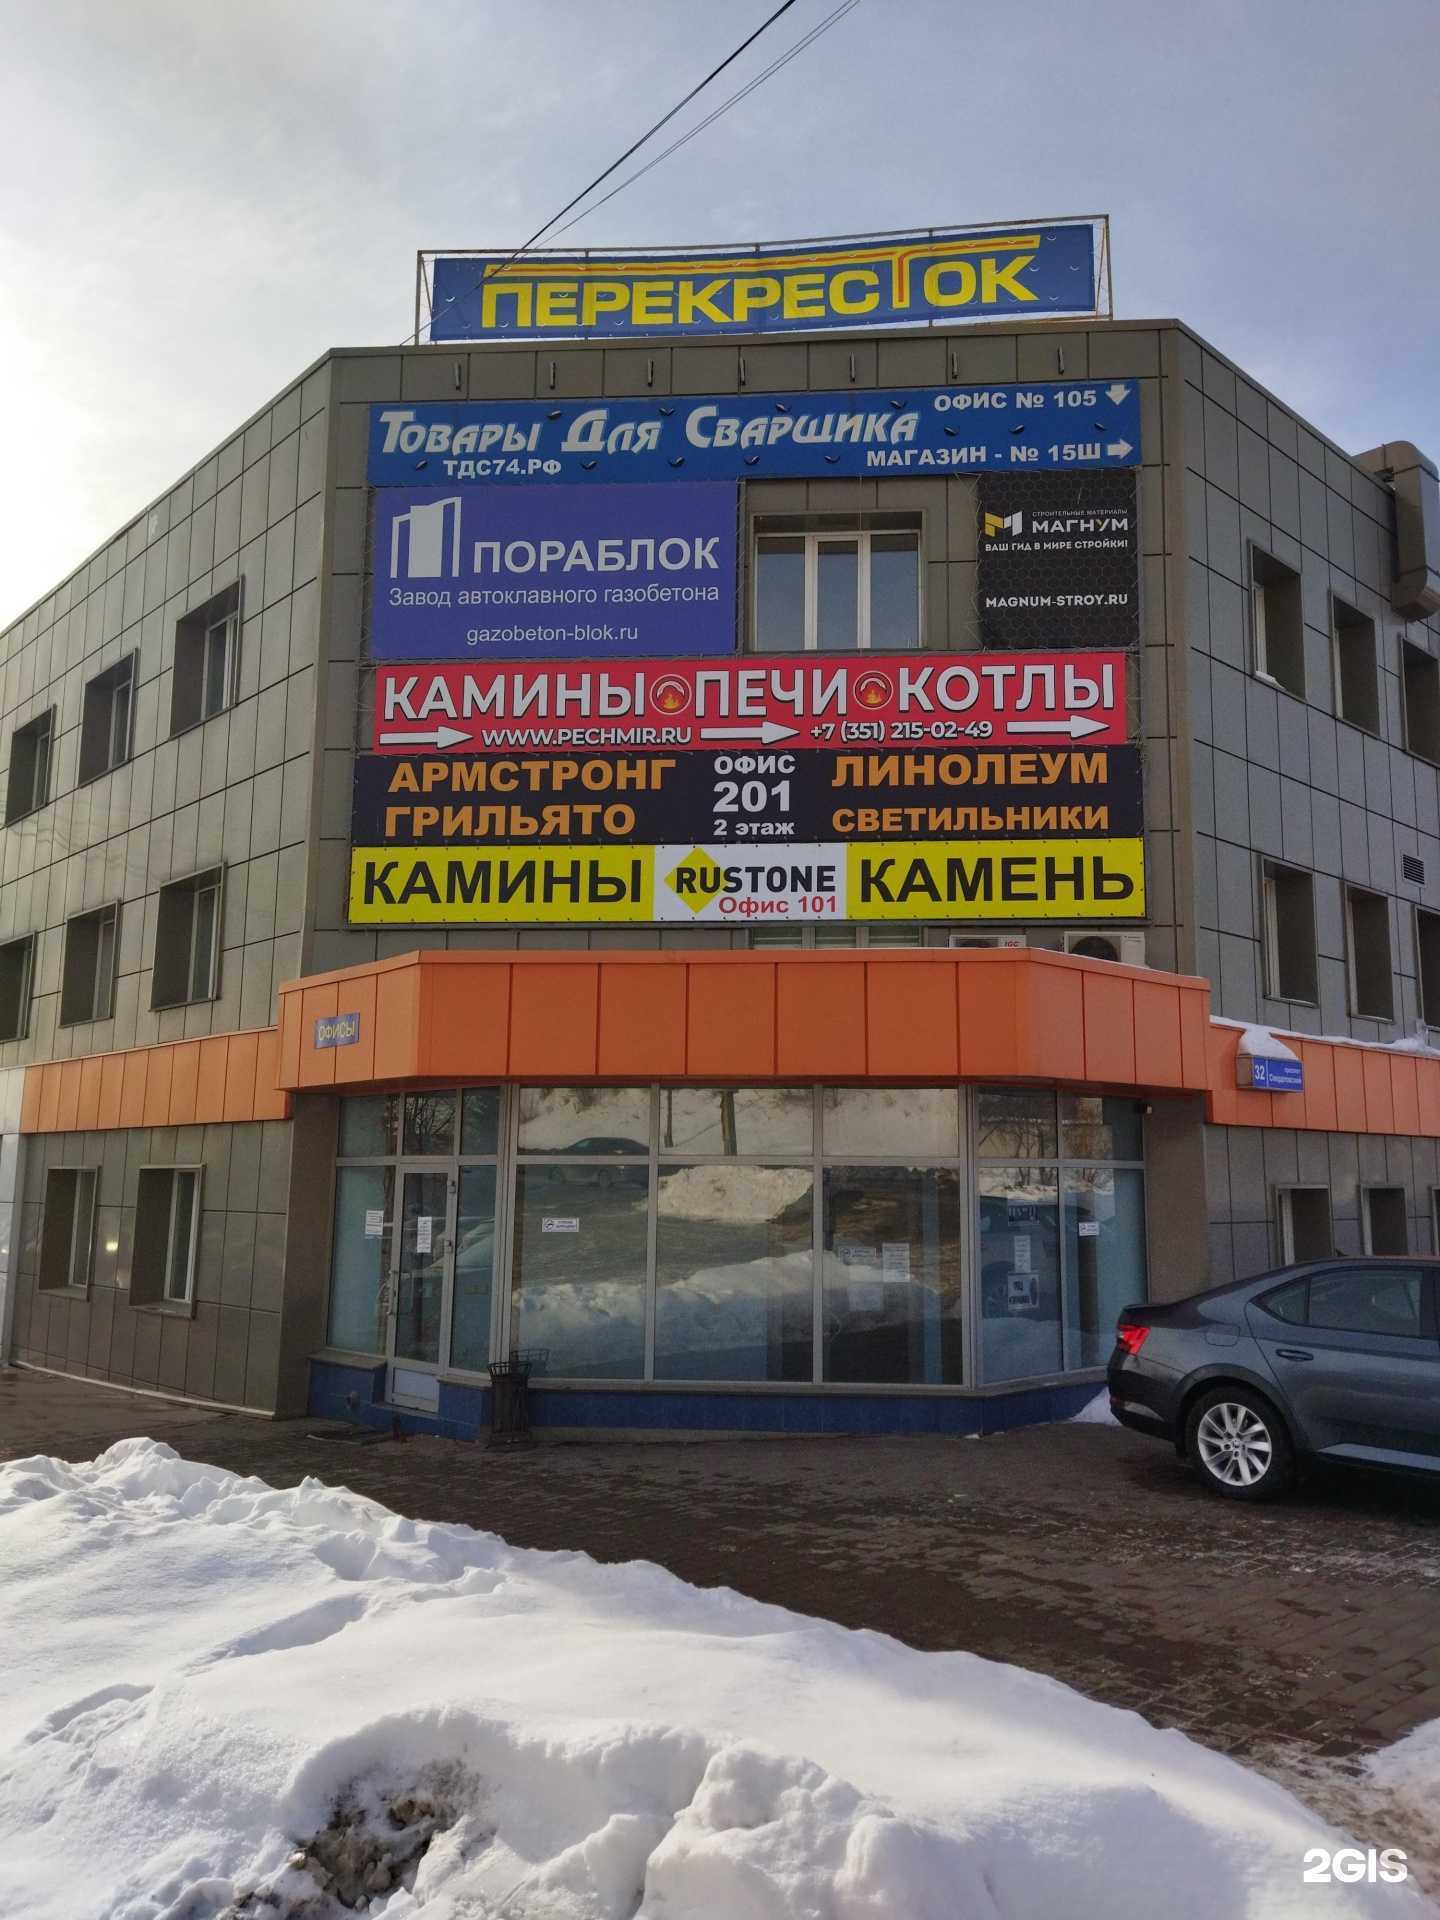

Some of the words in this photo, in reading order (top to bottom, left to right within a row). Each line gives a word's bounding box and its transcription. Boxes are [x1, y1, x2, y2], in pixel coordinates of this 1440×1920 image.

[482, 235, 1041, 329] ПЕРЕКРЕСТОК
[934, 393, 1007, 412] ОФИС
[1016, 392, 1045, 409] №
[1053, 390, 1097, 408] 105
[866, 446, 987, 467] МАГАЗИН
[1010, 446, 1039, 463] №
[1048, 442, 1101, 462] 15Ш
[443, 458, 562, 480] ТДС74.РФ
[1032, 518, 1129, 533] МАГНУМ
[473, 537, 720, 574] ПОРАБЛОК
[985, 543, 1009, 552] ВАШ
[1011, 542, 1032, 551] ГИД
[1034, 542, 1041, 550] В
[1043, 541, 1073, 550] МИРЕ
[1074, 538, 1128, 549] СТРОЙКИ!
[389, 587, 452, 609] Завод
[458, 587, 598, 605] автоклавного
[604, 584, 720, 603] газобетона
[985, 594, 1129, 608] MAGNUM-STROY.RU
[466, 624, 638, 645] gazobeton-blok.ru
[384, 672, 645, 721] КАМИНЫ
[695, 667, 848, 719] ПЕЧИ
[899, 663, 1115, 712] КОТЛЫ
[481, 726, 693, 747] WWW.PECHMIR.RU
[810, 723, 835, 741] +7
[840, 720, 886, 742] (351)
[890, 720, 993, 740] 215-02-49
[388, 759, 677, 793] АРМСТРОНГ
[714, 755, 796, 775] ОФИС
[832, 753, 1108, 787] ЛИНОЛЕУМ
[712, 780, 790, 813] 201
[384, 803, 637, 838] ГРИЛЬЯТО
[713, 819, 728, 836] 2
[735, 822, 795, 836] этаж
[832, 806, 1109, 833] СВЕТИЛЬНИКИ
[363, 859, 642, 905] КАМИНЫ
[675, 865, 836, 893] RUSTONE
[860, 856, 1135, 903] КАМЕНЬ
[718, 896, 790, 917] Офис
[798, 895, 837, 913] 101
[1254, 1065, 1266, 1080] 32
